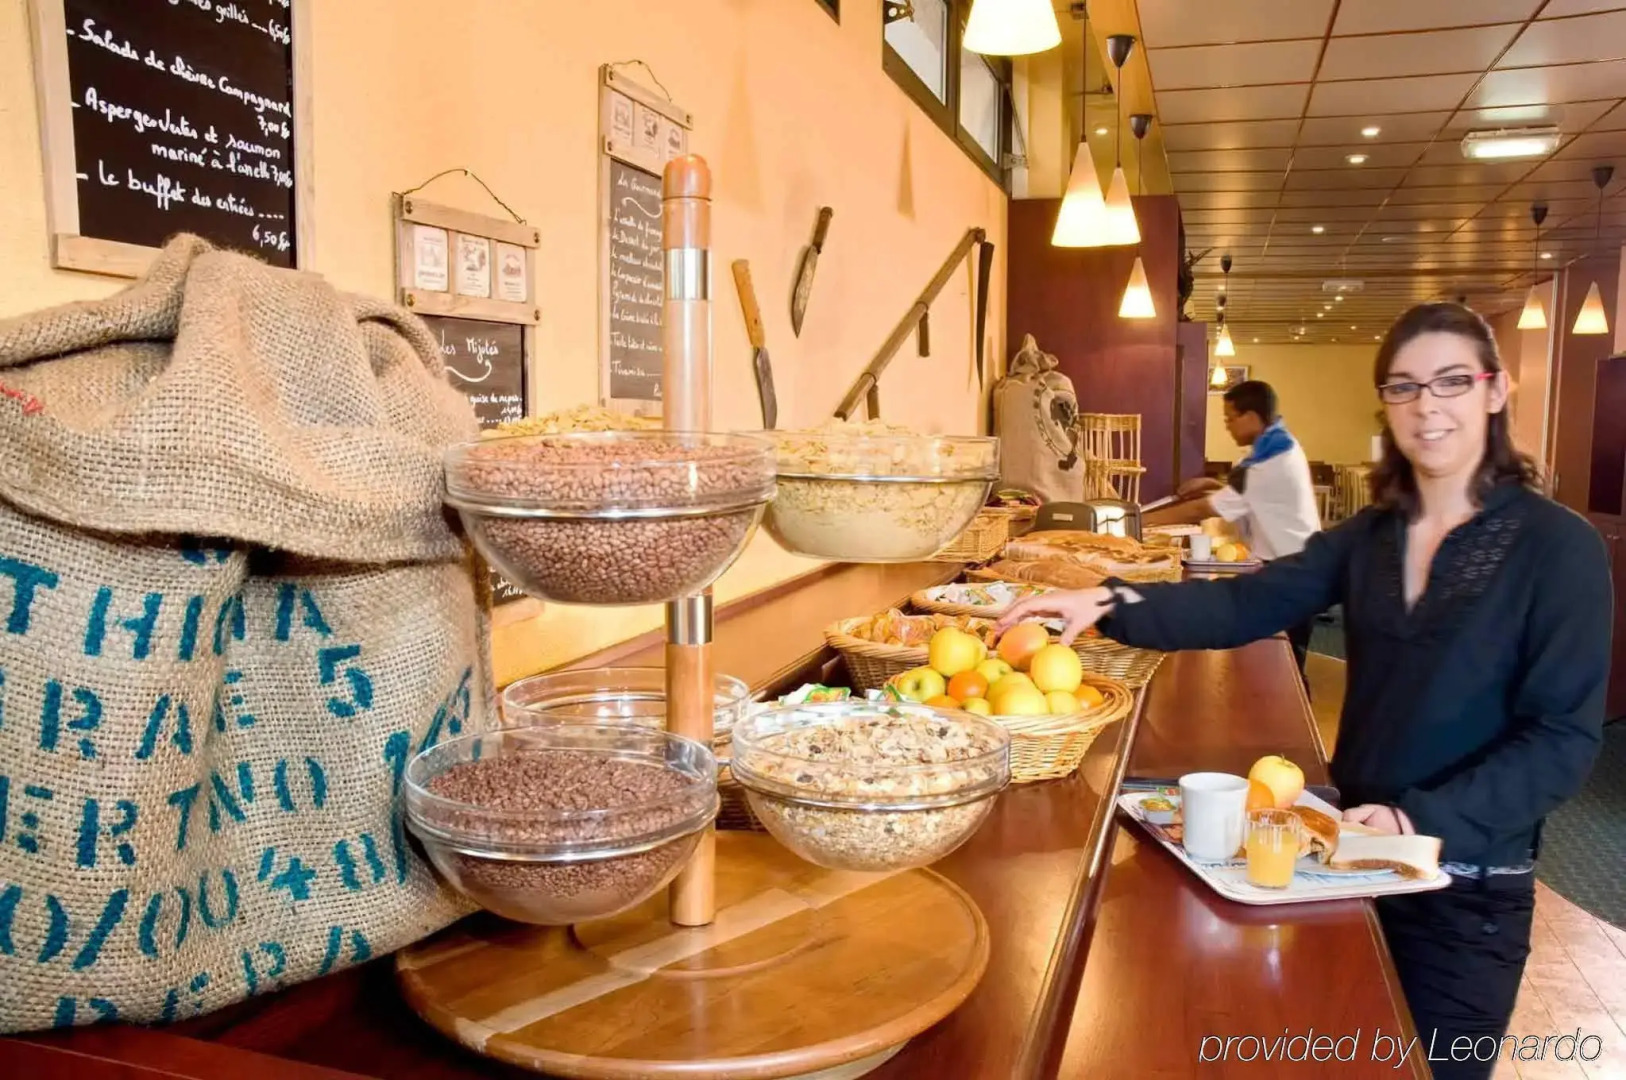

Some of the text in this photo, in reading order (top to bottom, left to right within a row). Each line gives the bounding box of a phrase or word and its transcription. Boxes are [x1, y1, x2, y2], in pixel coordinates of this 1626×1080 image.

[144, 50, 166, 71] de
[151, 143, 207, 168] mariné
[211, 149, 224, 170] à
[204, 125, 218, 144] et
[225, 133, 281, 160] saumon
[127, 168, 187, 211] buffet
[191, 187, 213, 208] des
[216, 193, 255, 217] entrées
[318, 644, 374, 719] 5
